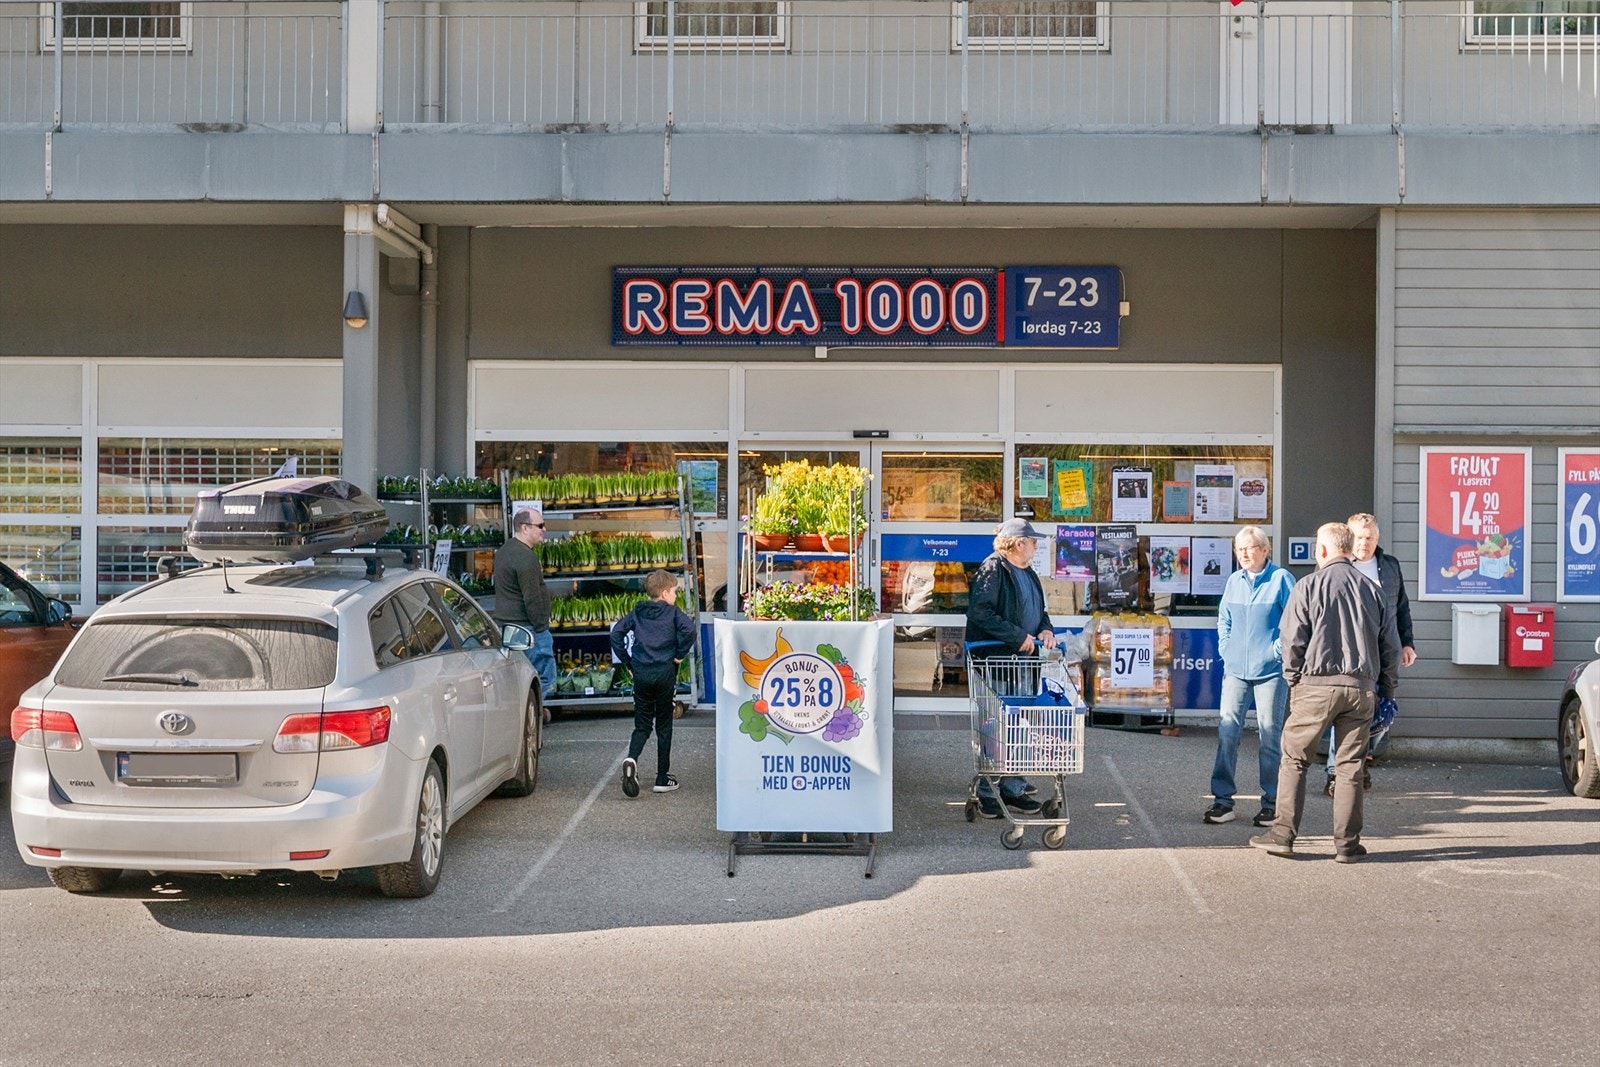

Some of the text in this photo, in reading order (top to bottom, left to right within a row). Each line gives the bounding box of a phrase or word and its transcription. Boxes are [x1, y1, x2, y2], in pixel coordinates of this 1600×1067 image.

[1024, 277, 1099, 307] 7-23
[622, 278, 990, 336] REMA 1000
[1022, 321, 1102, 336] lørdag 7-23
[1450, 455, 1501, 477] FRUKT
[1568, 470, 1587, 481] FYLL
[223, 505, 256, 515] THULE
[1450, 490, 1500, 535] 14 90
[1483, 515, 1497, 525] PR.
[1569, 492, 1600, 555] 6
[1058, 529, 1095, 538] Karaoke
[1483, 525, 1500, 535] KILO
[1295, 545, 1305, 557] P
[1525, 630, 1550, 638] posten
[785, 661, 819, 674] BONUS
[1115, 648, 1150, 675] 57 00
[771, 677, 800, 707] 25
[818, 677, 833, 707] 8
[761, 755, 851, 773] TJEN BONUS
[762, 776, 788, 790] MED
